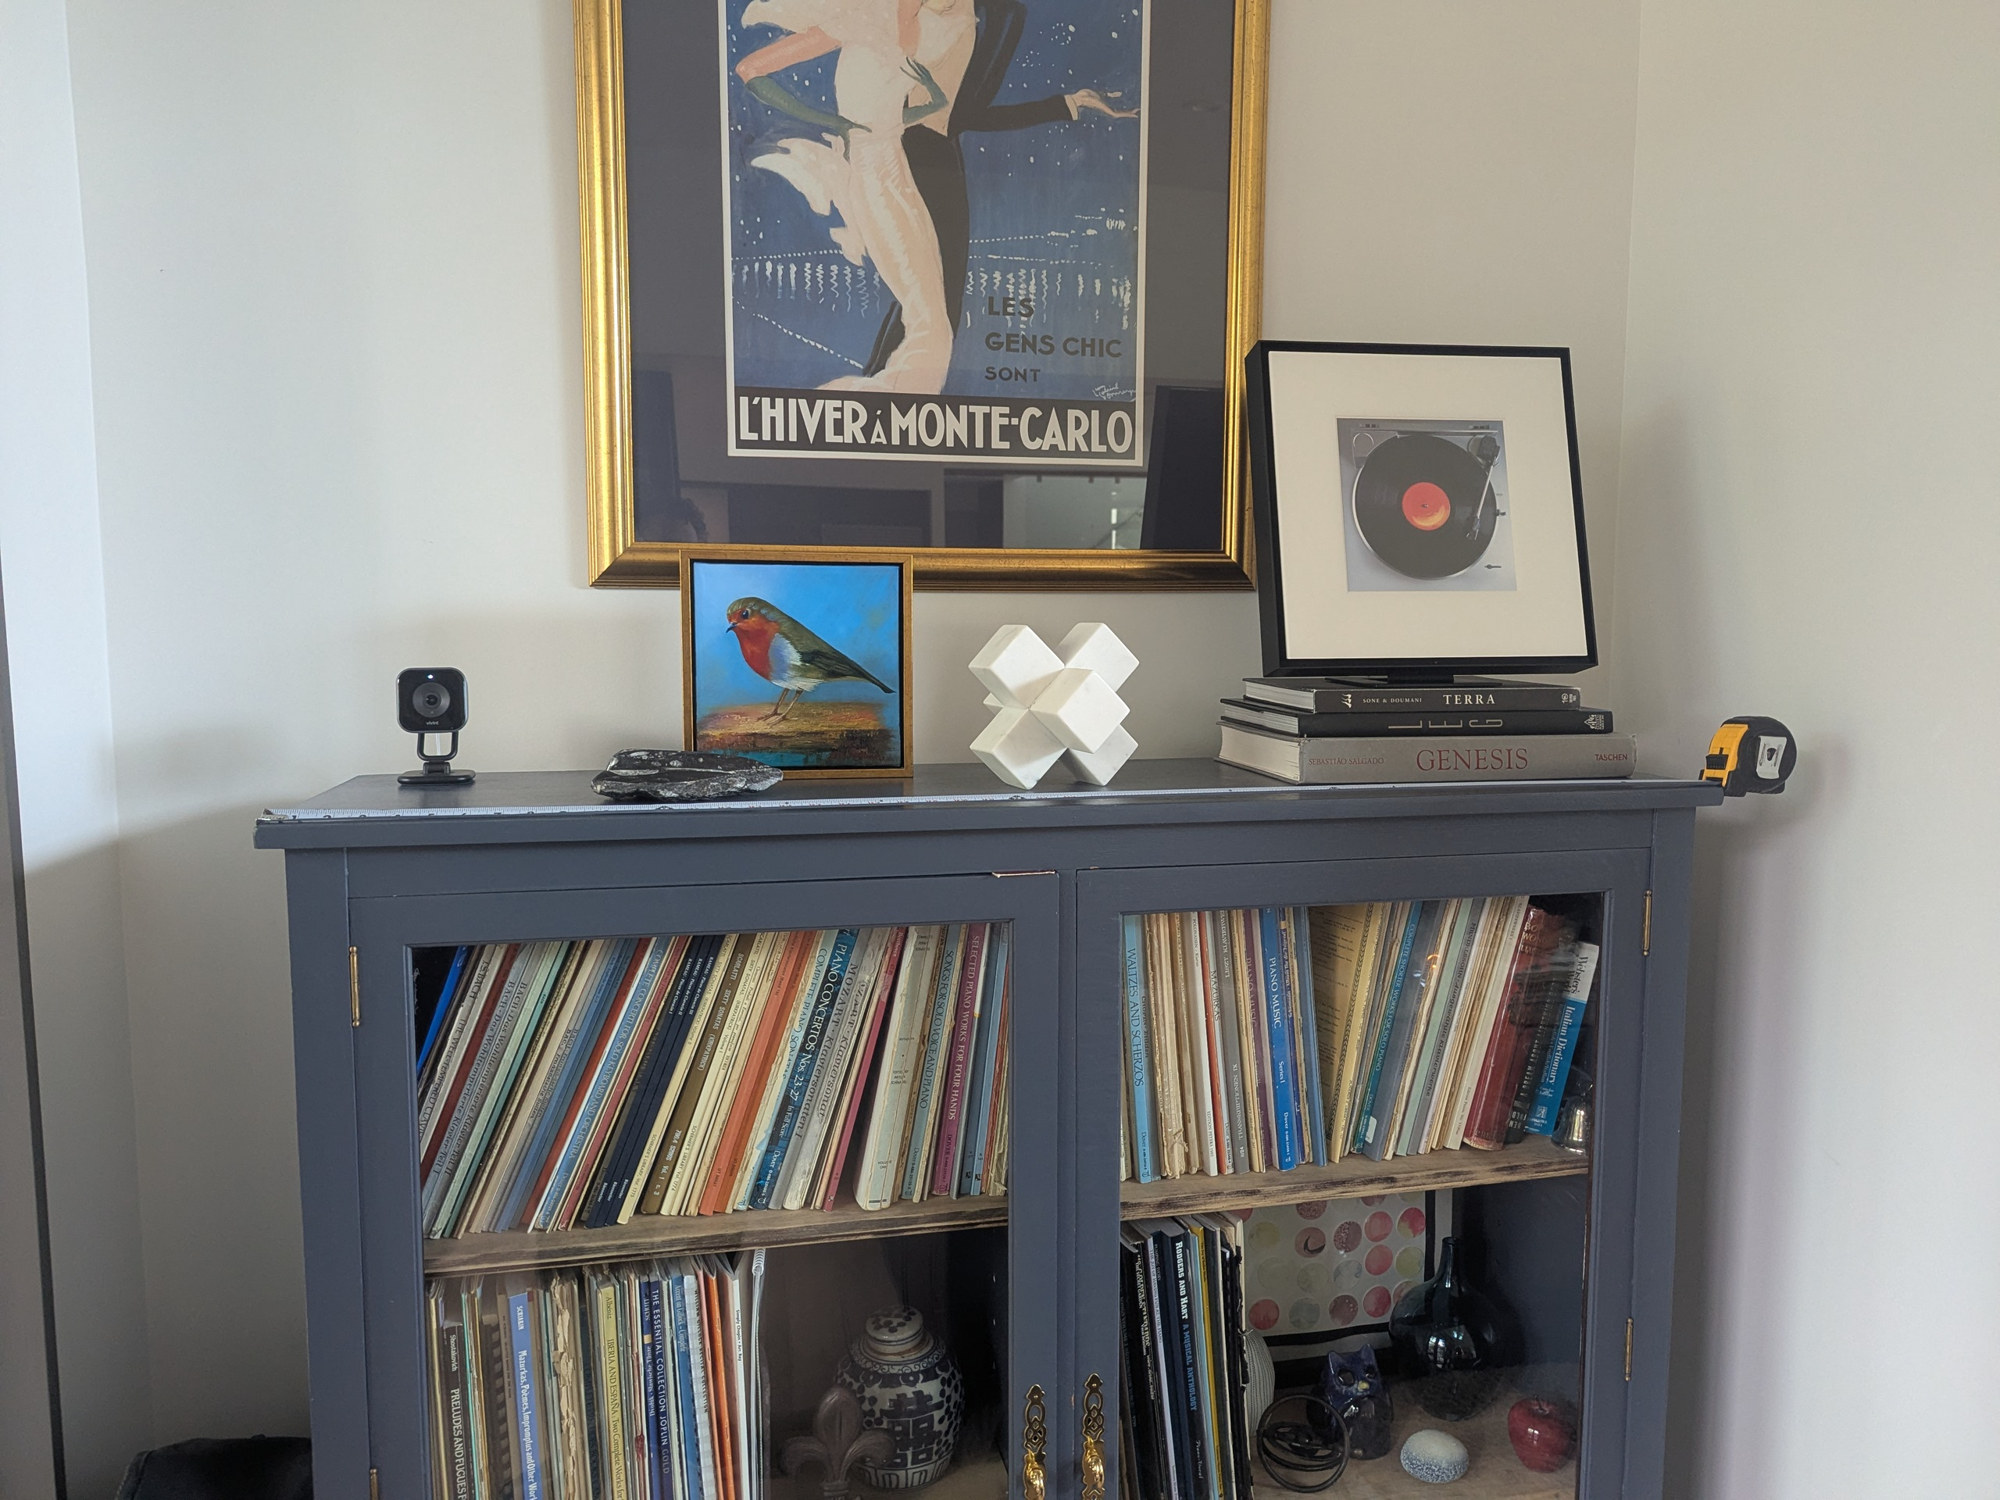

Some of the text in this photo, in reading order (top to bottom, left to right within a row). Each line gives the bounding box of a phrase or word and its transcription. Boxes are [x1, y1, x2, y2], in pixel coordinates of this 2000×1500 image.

[988, 296, 1034, 317] LES
[985, 332, 1122, 358] GENS CHIC
[985, 366, 1040, 382] SONT
[740, 397, 1133, 453] L'HIVER MONTE-CARLO
[1443, 694, 1496, 705] TERRA
[1348, 757, 1384, 766] SALGADO
[1416, 748, 1528, 772] GENESIS
[1595, 753, 1628, 761] TASCHEN
[642, 948, 664, 987] COMPLETE
[729, 952, 744, 980] SCARLATTI
[826, 943, 847, 982] PIANO
[941, 950, 954, 982] SONGS
[966, 935, 980, 978] SELECTED
[1125, 948, 1138, 997] WALTZES
[1267, 957, 1279, 991] PIANO
[1569, 954, 1589, 995] Webster's
[498, 981, 514, 1008] BACH
[510, 982, 527, 1009] BACH
[626, 987, 647, 1024] CONCERTI
[721, 988, 731, 1004] SIXTY
[830, 963, 858, 1026] MOZART
[938, 983, 949, 1002] FOR
[962, 980, 974, 1008] PIANO
[1210, 970, 1221, 1021] MAZURKAS
[1374, 922, 1416, 1071] COMPLETE SHORTER WORKS FOR SOLO PIANO
[489, 1013, 501, 1032] Das
[501, 1013, 514, 1033] Das
[711, 1005, 725, 1030] SONATAS
[805, 981, 834, 1051] CONCERTOS
[934, 1002, 946, 1028] SOLO
[1129, 1000, 1140, 1026] AND
[1270, 994, 1281, 1028] MUSIC
[1558, 1005, 1576, 1037] Italian
[619, 1024, 631, 1040] FOR
[958, 1010, 970, 1042] WORKS
[610, 1040, 624, 1061] SOLO
[929, 1027, 943, 1056] VOICE
[955, 1044, 965, 1061] FOR
[796, 1052, 812, 1074] Nos.
[923, 1054, 937, 1078] AND
[1130, 1030, 1144, 1087] SCHERZOS
[1424, 1038, 1445, 1097] Klavierwerke
[1545, 1036, 1568, 1084] Dictionary
[593, 1060, 615, 1099] KEYBOARD
[788, 1074, 803, 1100] 23-27
[796, 1035, 834, 1129] Klaviersonaten
[952, 1063, 962, 1087] FOUR
[586, 1098, 599, 1116] AND
[918, 1078, 932, 1108] PIANO
[947, 1089, 959, 1120] HANDS
[783, 1111, 791, 1122] Full
[786, 1104, 793, 1112] In
[441, 1115, 461, 1149] Klavier
[454, 1113, 473, 1148] Klavier
[567, 1115, 592, 1159] ORCHESTRA
[778, 1122, 788, 1138] Score
[1174, 1241, 1185, 1278] RODGERS
[1178, 1280, 1186, 1295] AND
[514, 1305, 526, 1330] SCRIABIN
[1179, 1295, 1189, 1319] HART
[448, 1334, 458, 1371] Shostakovich
[606, 1339, 616, 1363] IBERIA
[1182, 1330, 1193, 1365] MUSICAL
[518, 1349, 528, 1384] Mazurkas,
[608, 1366, 617, 1384] AND
[651, 1290, 670, 1473] THE ESSENTIAL COLLECTION JOPLIN GOLD
[1186, 1366, 1197, 1411] ANTHOLOGY
[520, 1384, 530, 1411] Poèmes,
[448, 1388, 464, 1436] PRELUDES
[520, 1411, 533, 1451] Impromptus
[452, 1436, 463, 1457] AND
[611, 1434, 622, 1466] Complete
[454, 1458, 467, 1493] FUGUES
[526, 1463, 535, 1482] Other
[615, 1467, 623, 1488] Works
[616, 1489, 624, 1498] for
